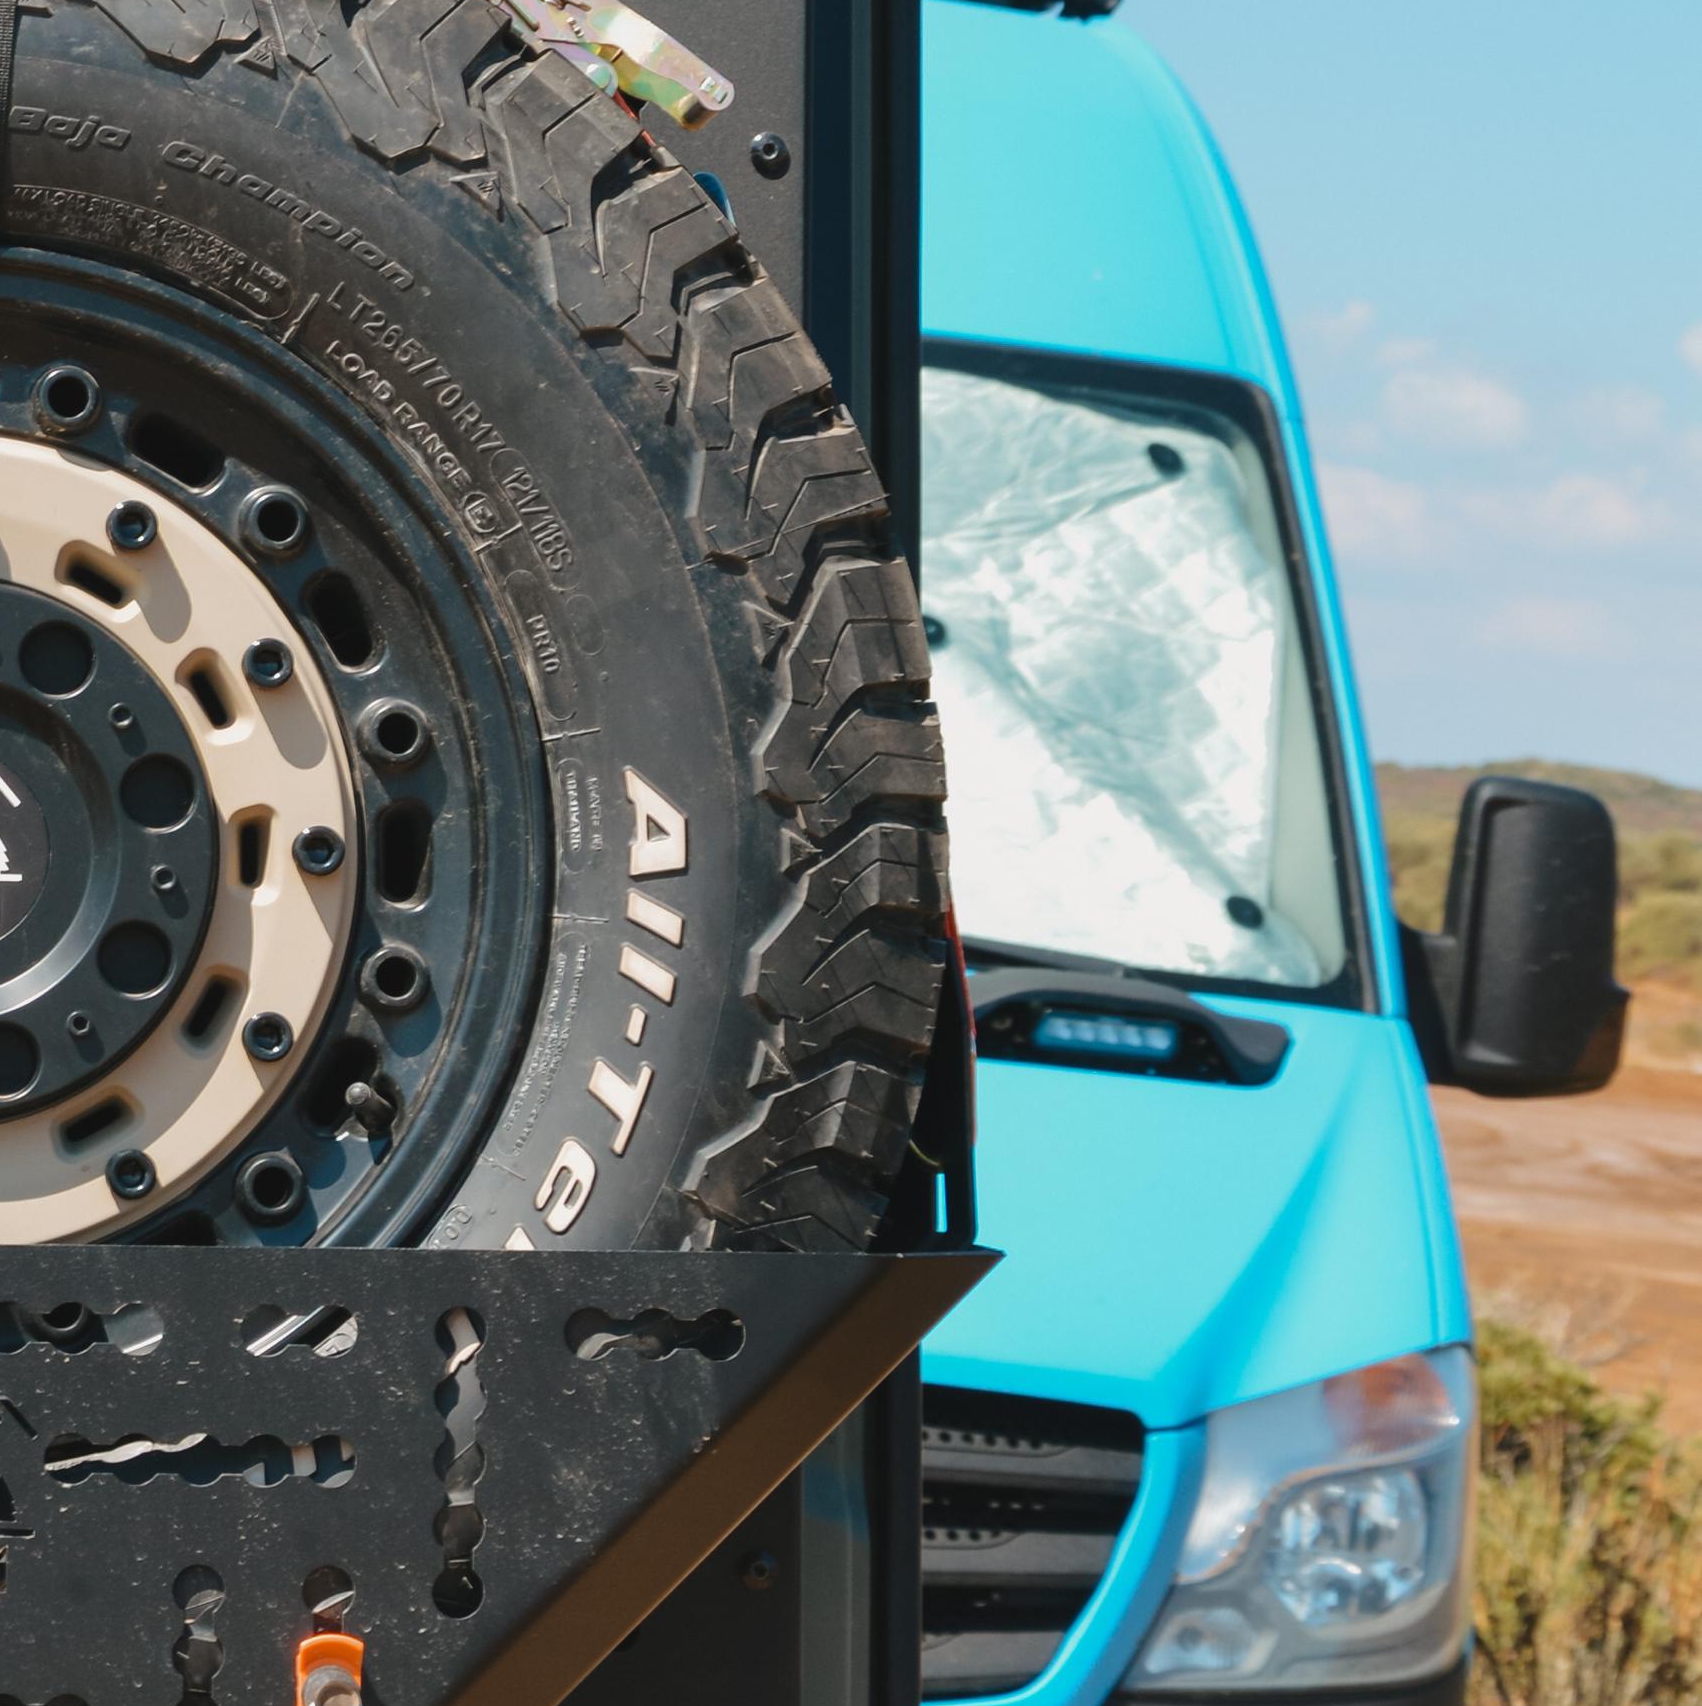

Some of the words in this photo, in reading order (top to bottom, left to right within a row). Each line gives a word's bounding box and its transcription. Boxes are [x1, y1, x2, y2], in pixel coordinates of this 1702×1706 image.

[8, 105, 132, 150] Baja
[162, 140, 416, 291] Champion
[324, 339, 395, 401] LOAD
[393, 401, 471, 490] RANGE
[504, 766, 688, 1250] All-Te
